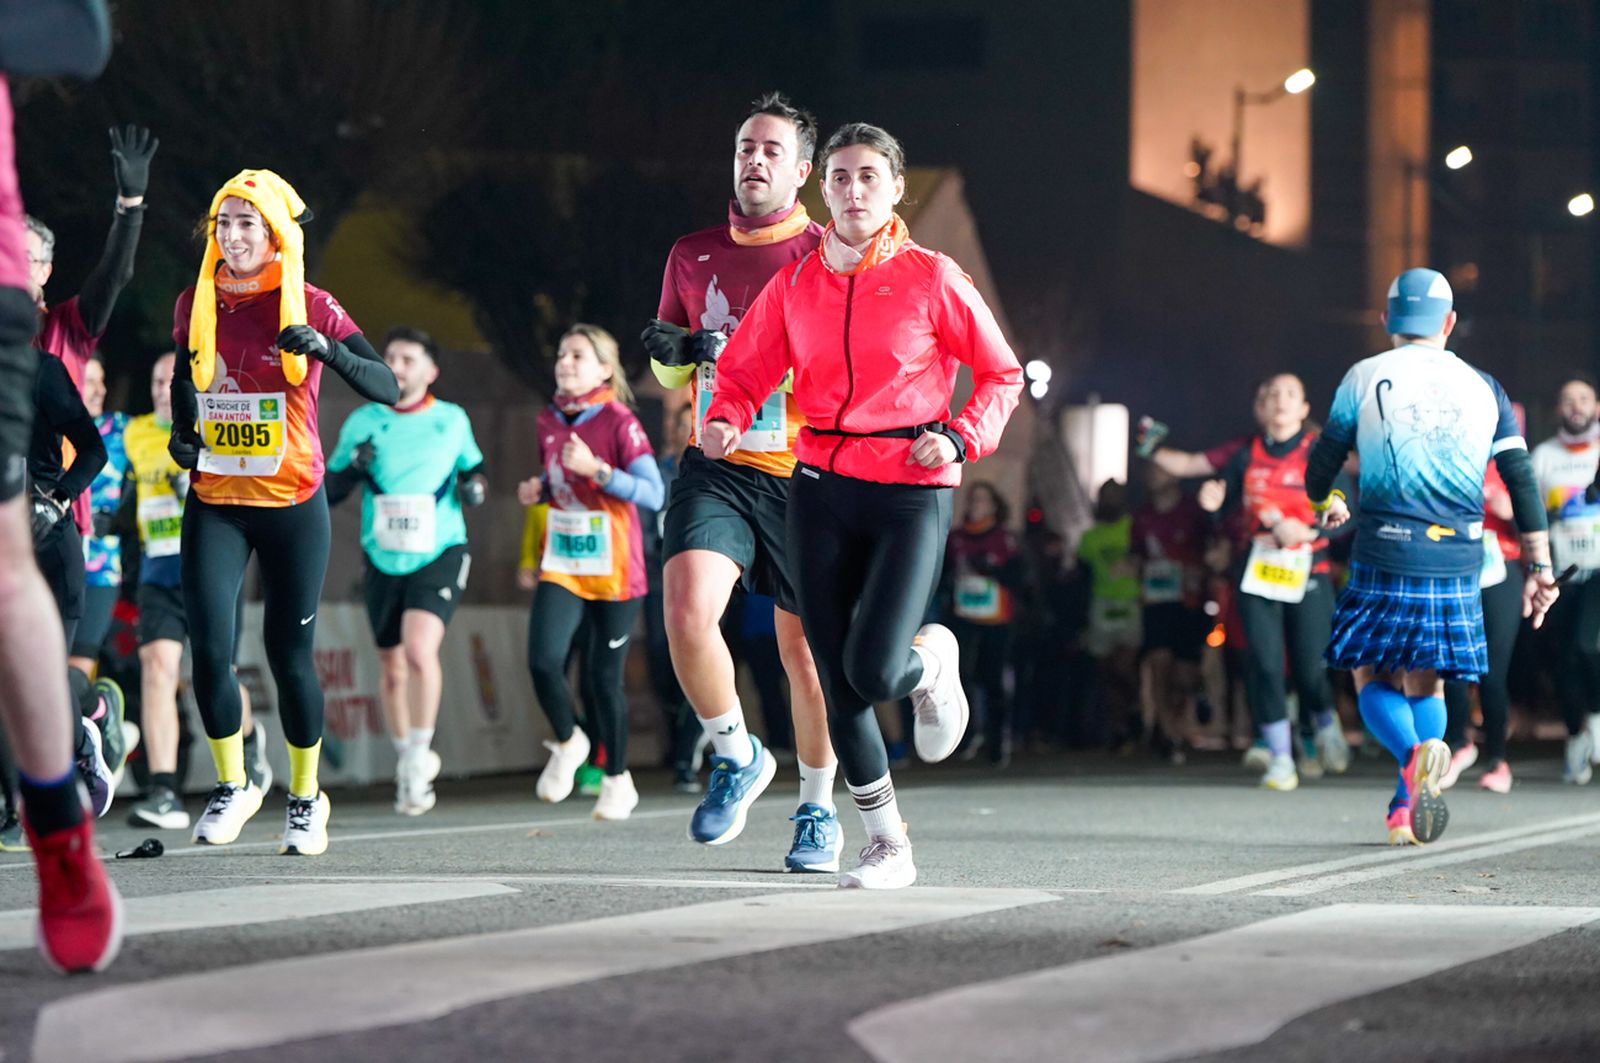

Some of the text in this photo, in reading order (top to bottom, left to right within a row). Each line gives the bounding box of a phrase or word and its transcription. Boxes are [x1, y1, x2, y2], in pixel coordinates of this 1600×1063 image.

[216, 402, 239, 411] NOCHE
[241, 403, 250, 411] DE
[208, 411, 224, 421] SAN
[224, 411, 252, 422] ANTÓN
[214, 422, 270, 447] 2095
